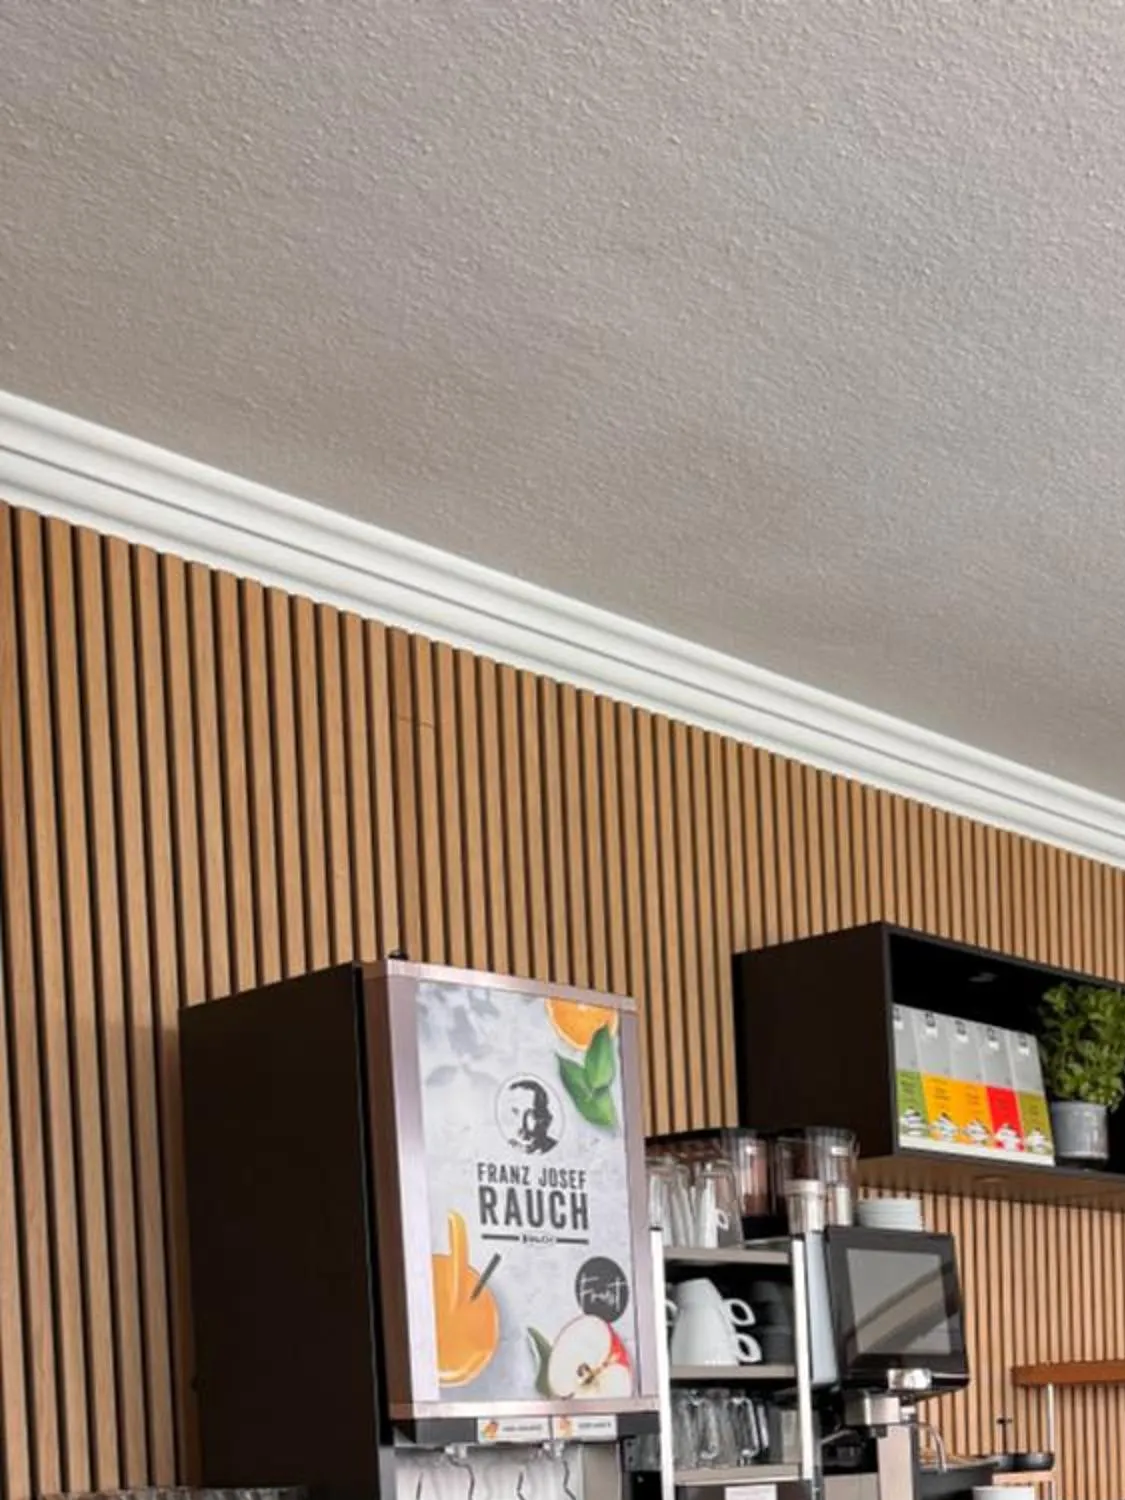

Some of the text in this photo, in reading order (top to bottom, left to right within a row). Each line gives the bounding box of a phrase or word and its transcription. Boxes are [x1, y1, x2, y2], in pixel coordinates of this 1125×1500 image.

[477, 1162, 586, 1189] FRANZ JOSEF
[479, 1185, 588, 1230] RAUCH
